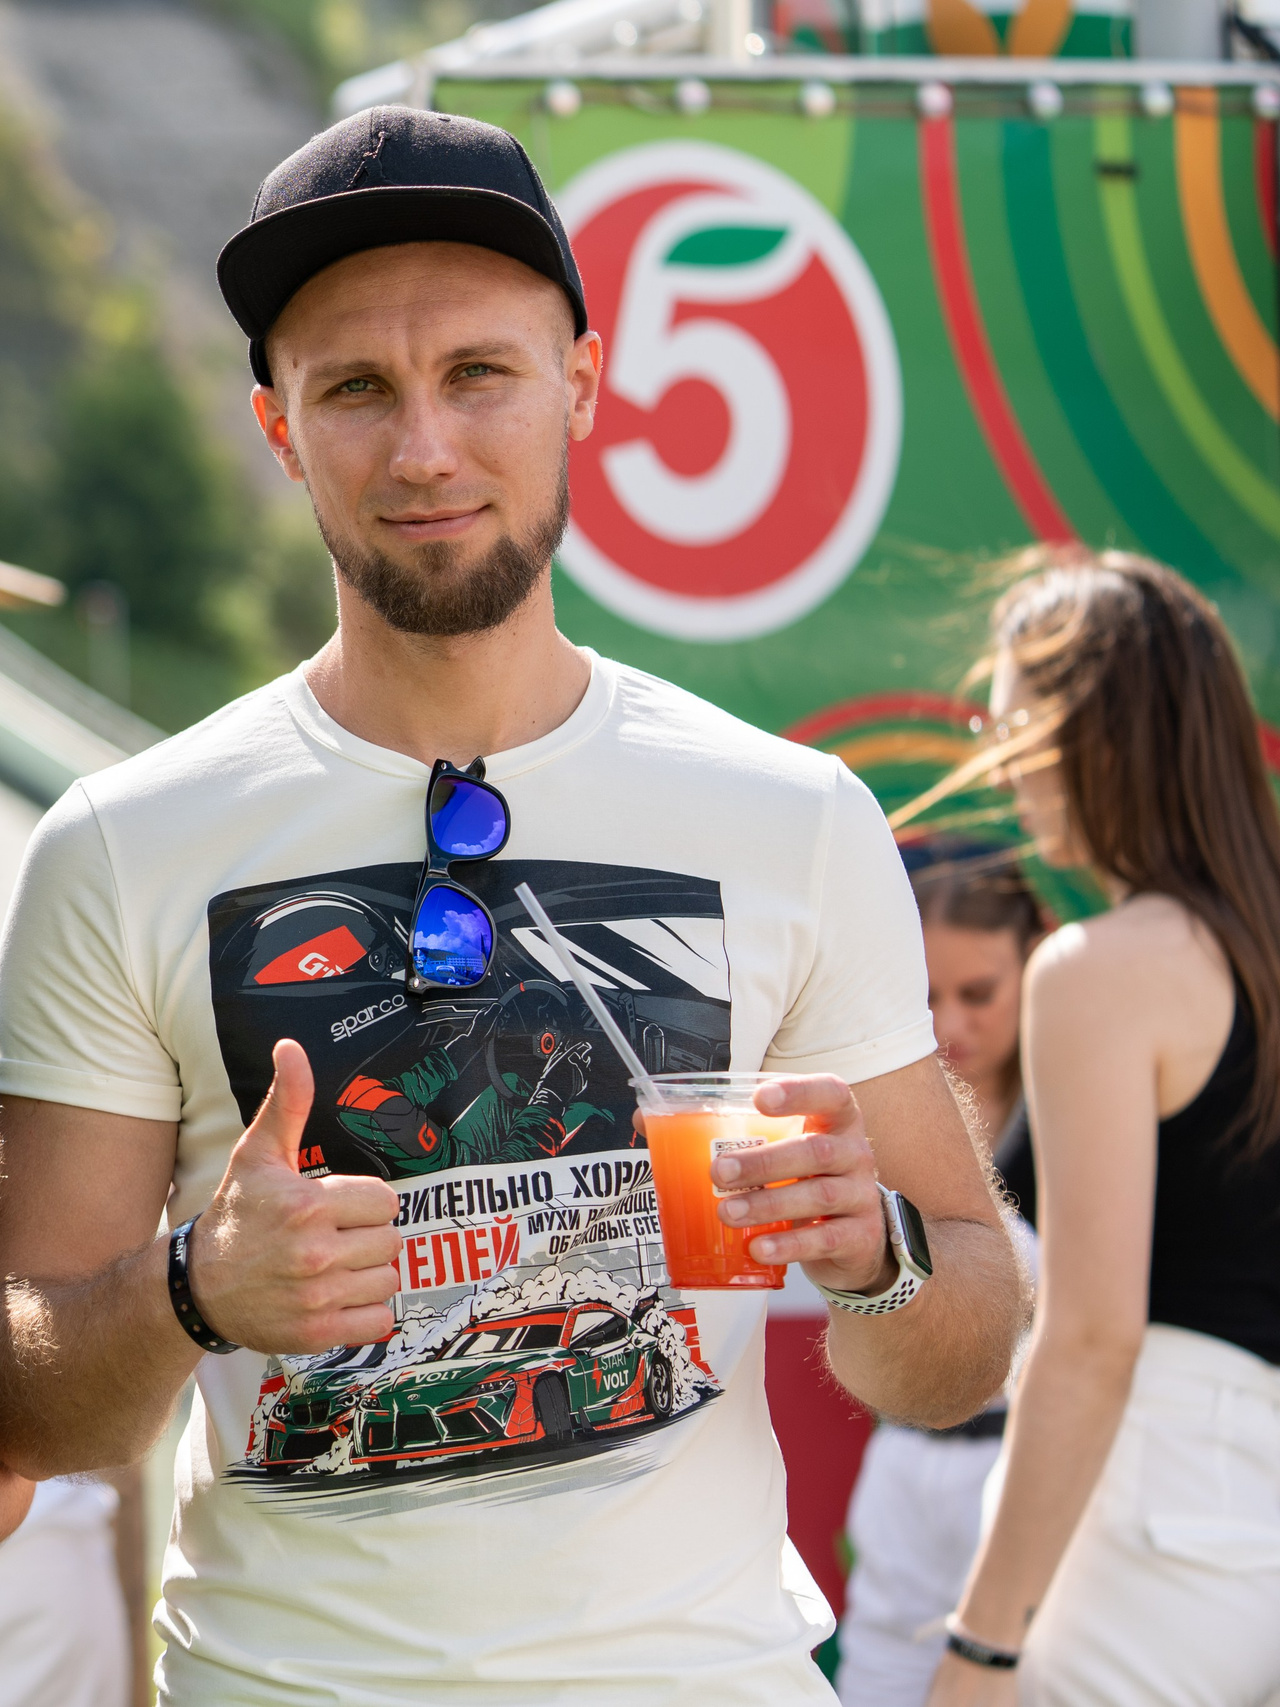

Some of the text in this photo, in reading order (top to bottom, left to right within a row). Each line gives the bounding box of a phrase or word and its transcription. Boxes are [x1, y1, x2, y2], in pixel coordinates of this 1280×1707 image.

[601, 191, 811, 546] 5
[330, 994, 407, 1040] sparco
[300, 1166, 332, 1179] IGINAL
[528, 1209, 580, 1235] МУХИ
[548, 1235, 571, 1255] ОБ
[632, 1215, 661, 1237] СТЕ
[414, 1370, 462, 1384] VOLT
[603, 1370, 629, 1391] VOLT
